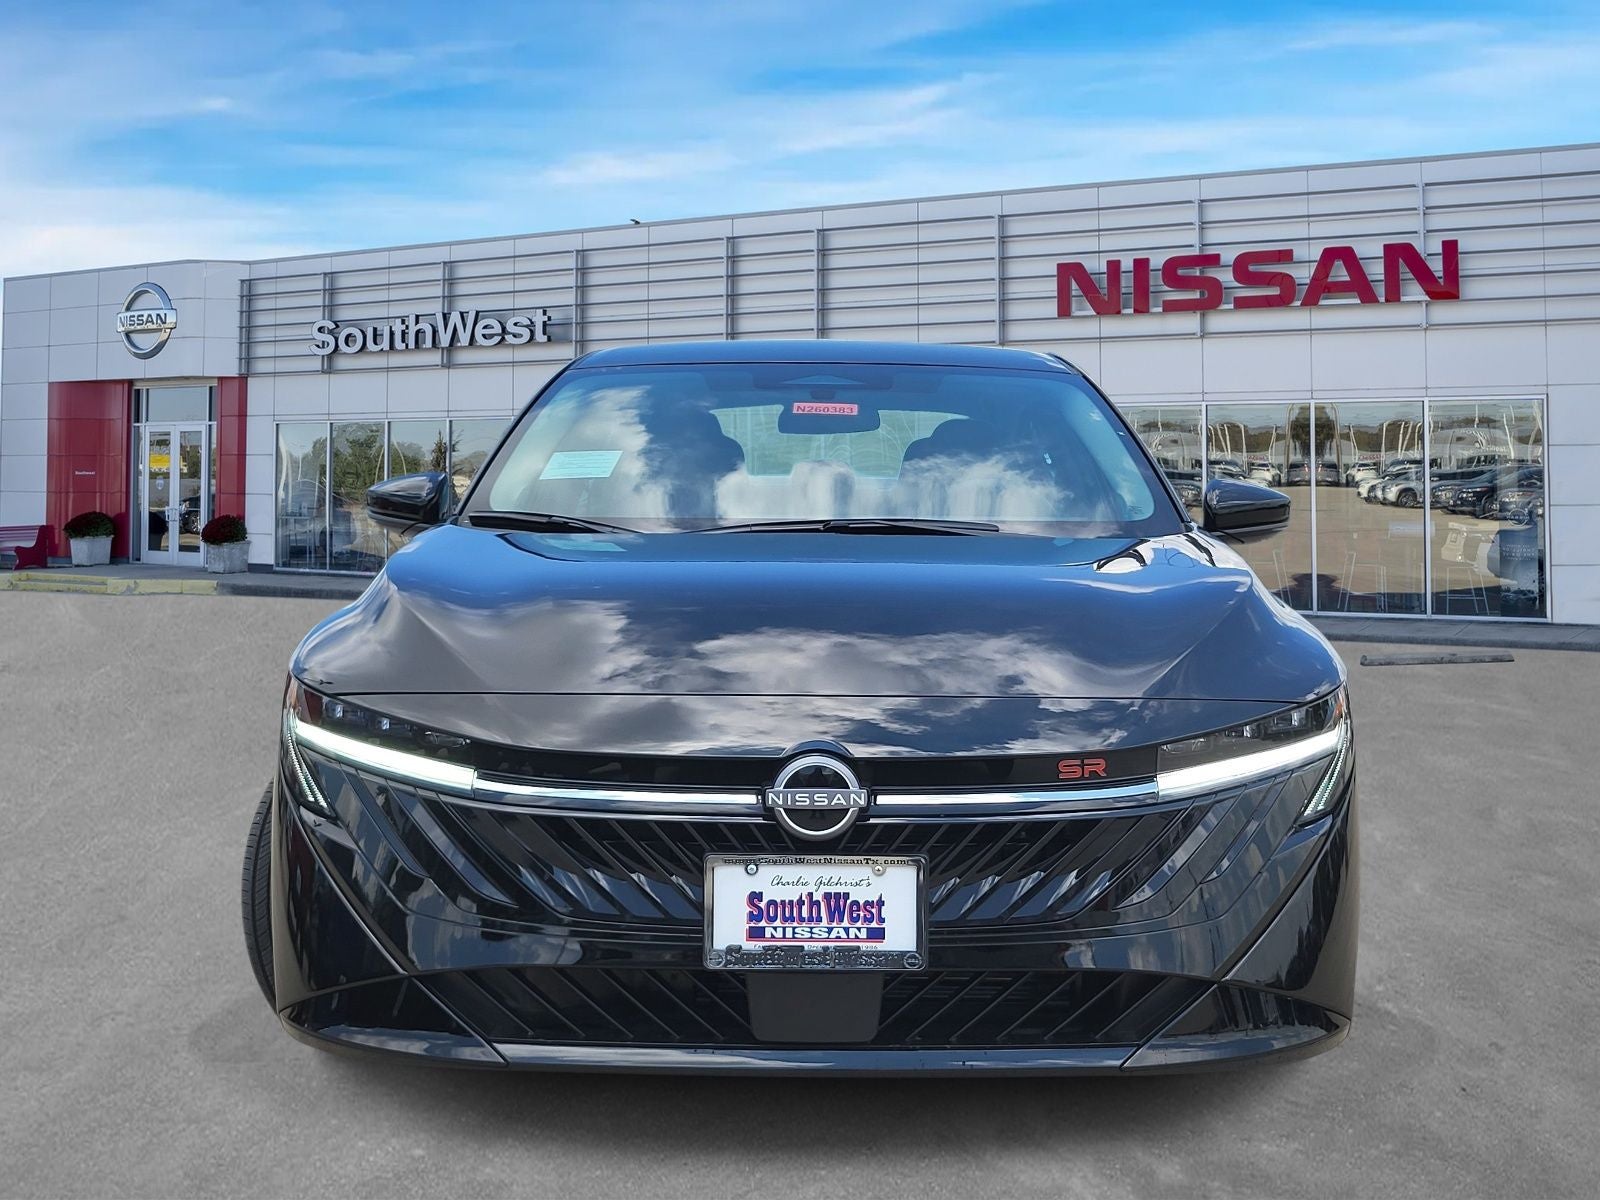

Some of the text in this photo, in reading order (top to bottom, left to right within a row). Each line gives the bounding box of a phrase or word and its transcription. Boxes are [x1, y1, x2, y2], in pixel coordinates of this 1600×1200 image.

[1056, 239, 1460, 319] NISSAN
[119, 312, 167, 328] NISSAN
[310, 309, 551, 355] SouthWest
[796, 405, 854, 414] N260383
[1057, 758, 1107, 779] SR
[768, 792, 866, 806] NISSAN
[770, 875, 872, 892] Charlie Gilchrist's
[746, 891, 886, 926] SouthWest
[765, 927, 868, 939] NISSAN
